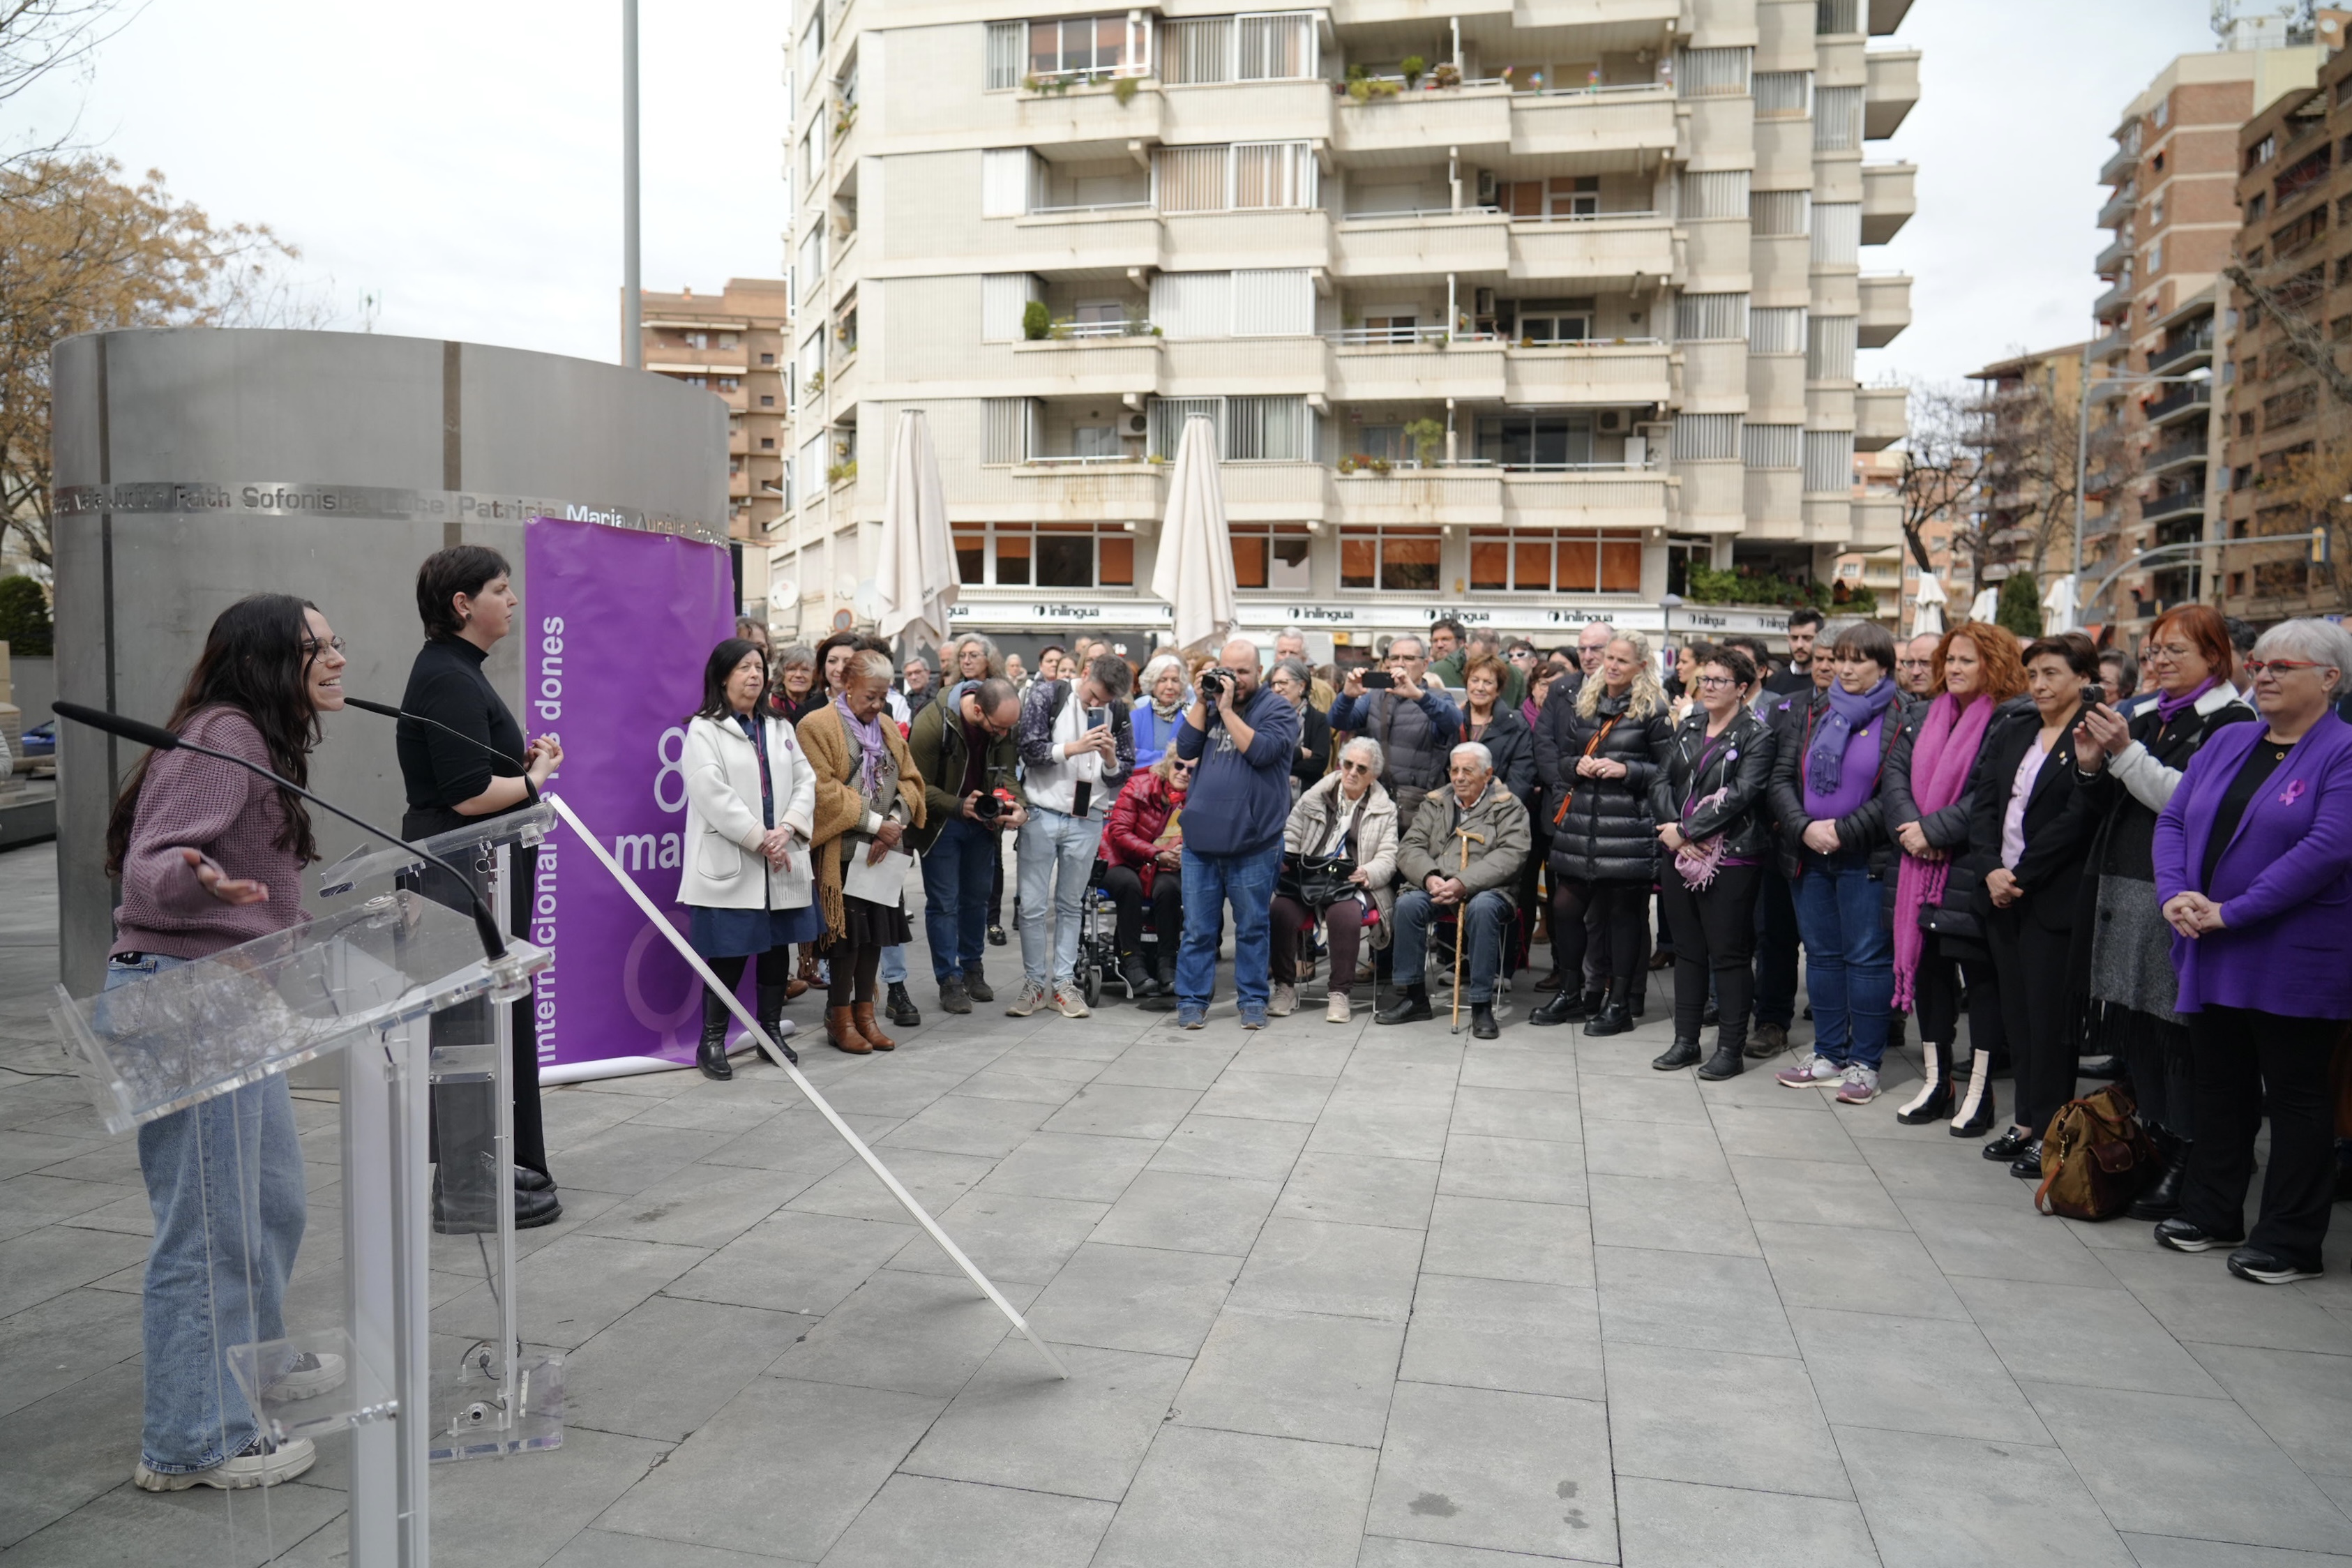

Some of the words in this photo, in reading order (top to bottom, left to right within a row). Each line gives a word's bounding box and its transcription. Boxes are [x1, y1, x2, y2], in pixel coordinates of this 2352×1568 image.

[174, 485, 231, 508] Faith
[243, 487, 368, 514] Sofonisba
[458, 495, 556, 520] Patricia
[1050, 604, 1099, 619] inlingua
[1304, 606, 1353, 621] inlingua
[534, 616, 564, 721] dones
[654, 726, 688, 813] 8
[615, 831, 686, 871] ma
